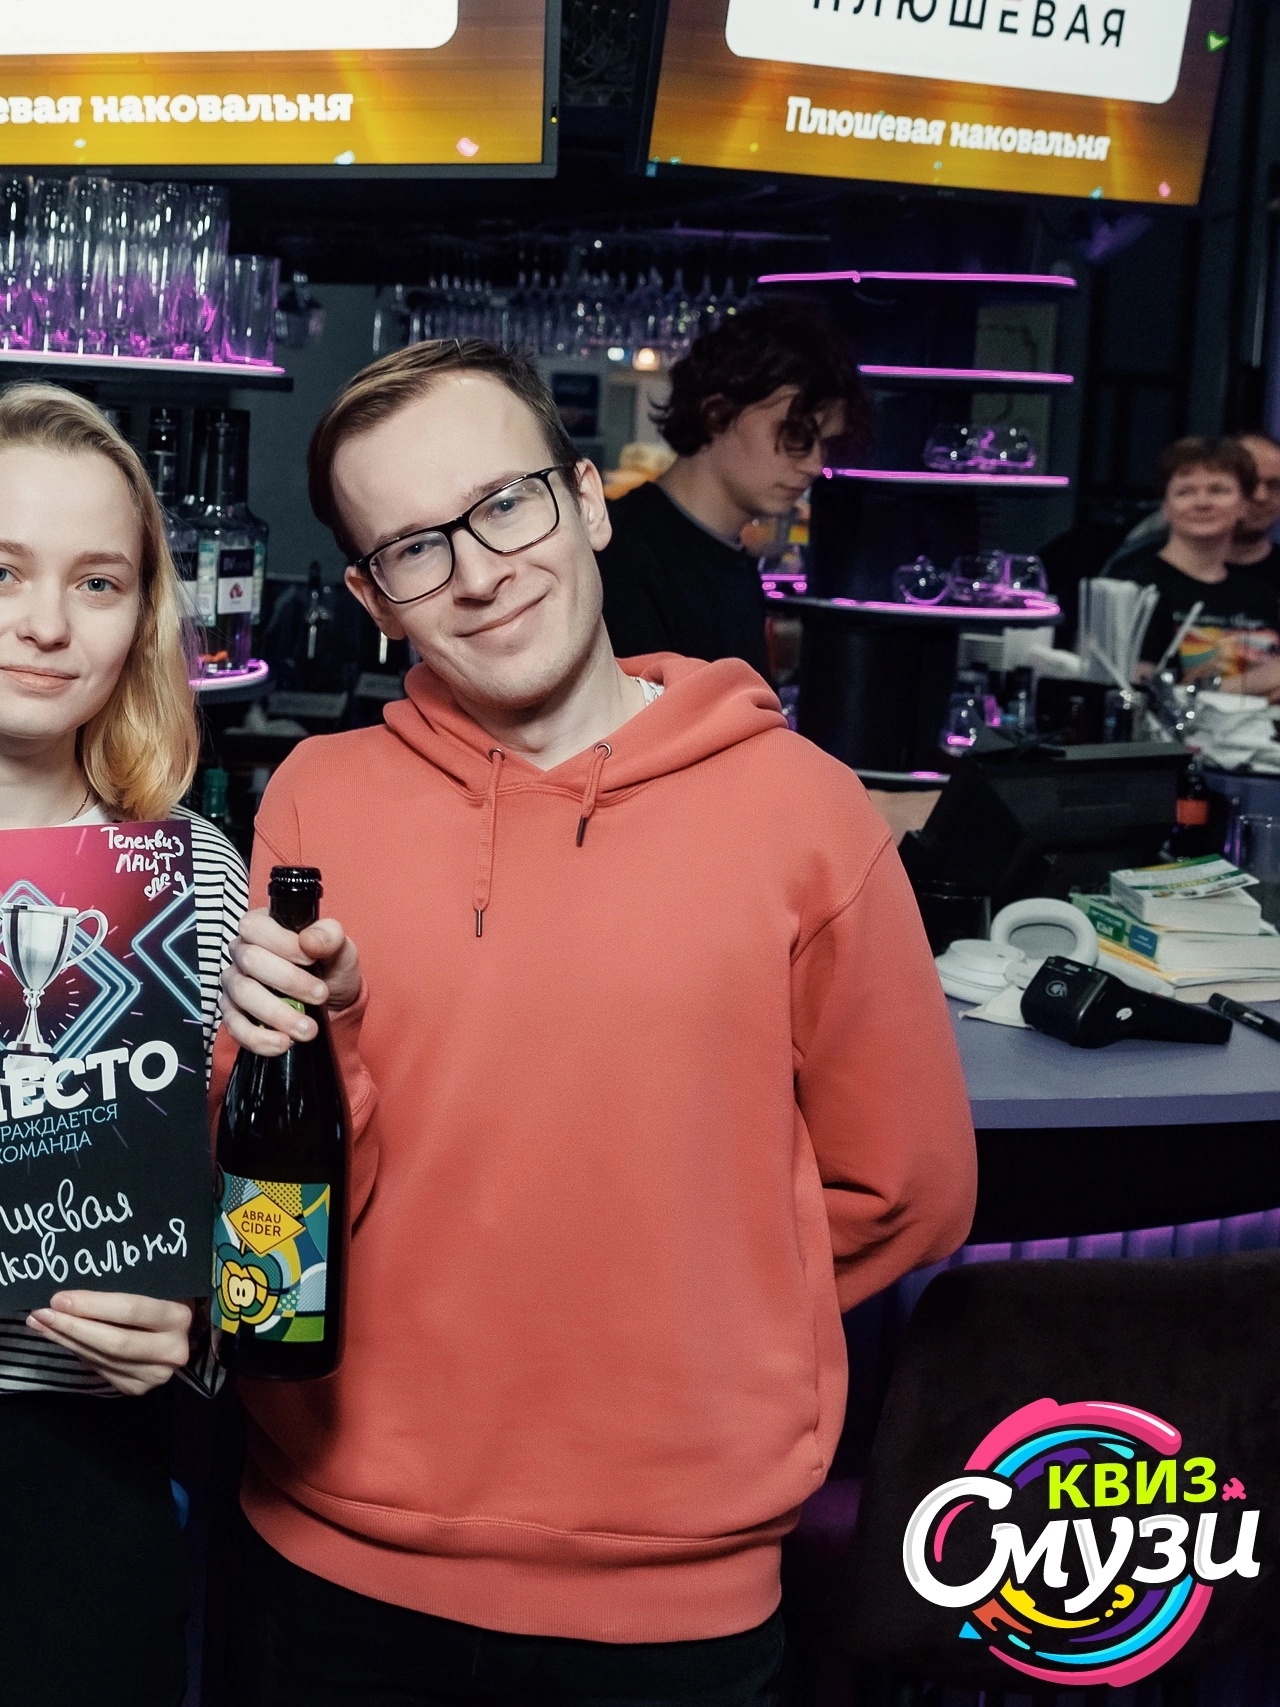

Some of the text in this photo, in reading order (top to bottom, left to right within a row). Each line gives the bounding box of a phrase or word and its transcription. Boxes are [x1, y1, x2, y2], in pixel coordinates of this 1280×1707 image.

[812, 0, 1125, 47] ЮШЕВАЯ
[90, 93, 354, 124] наковальня
[786, 96, 1111, 161] Плюшевая наковальня
[240, 1221, 282, 1237] CIDER
[241, 1209, 282, 1224] ABRAU
